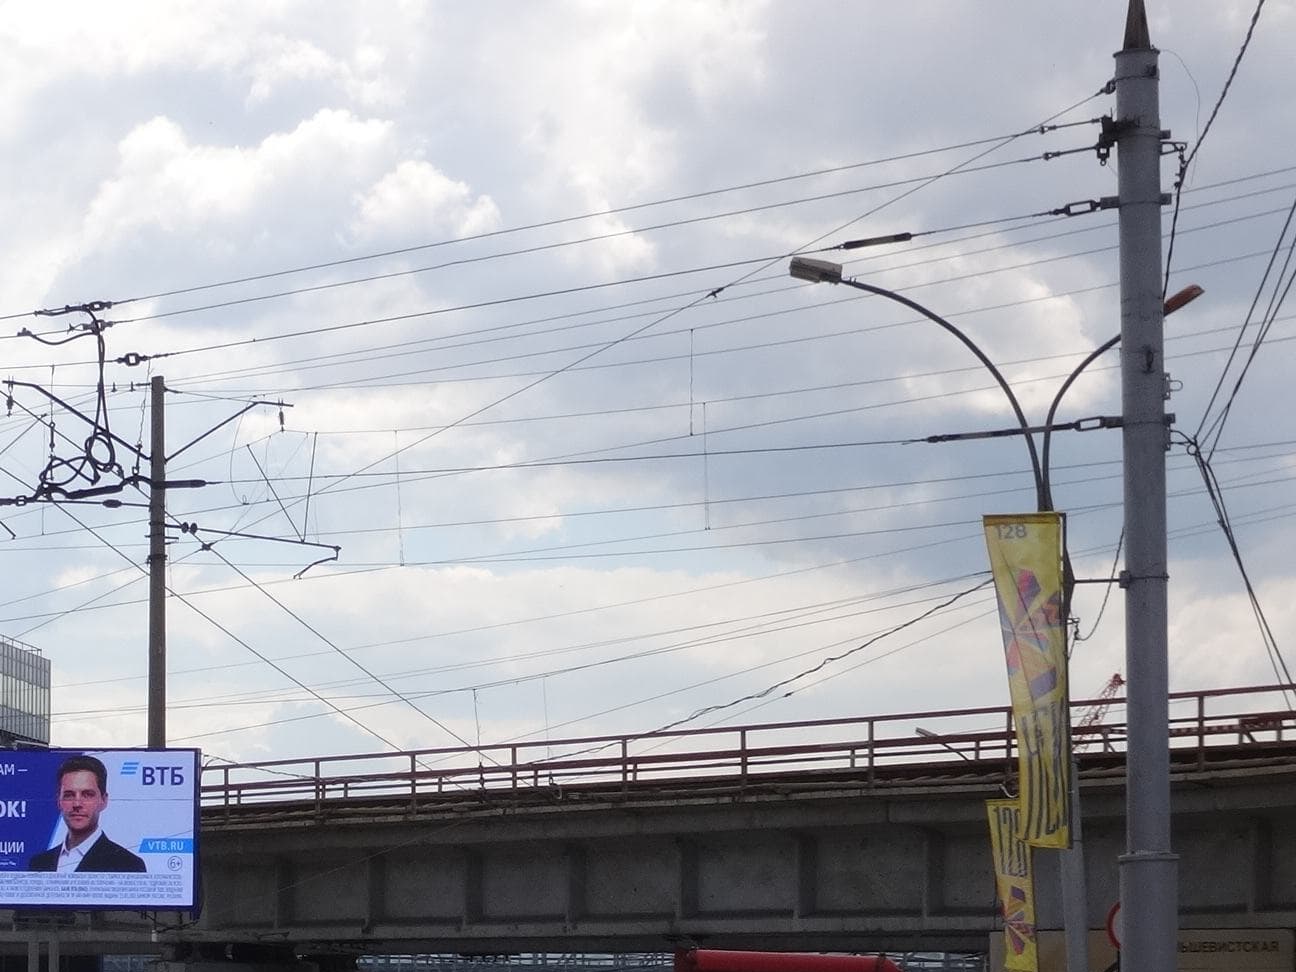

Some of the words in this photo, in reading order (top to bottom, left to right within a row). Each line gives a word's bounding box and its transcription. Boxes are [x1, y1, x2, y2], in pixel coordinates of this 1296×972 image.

[998, 524, 1027, 540] 128
[142, 766, 184, 786] ВТБ
[147, 841, 184, 851] VTB.RU
[169, 857, 181, 869] 6+
[1176, 940, 1279, 953] ЬШЕВИСТСКАЯ
